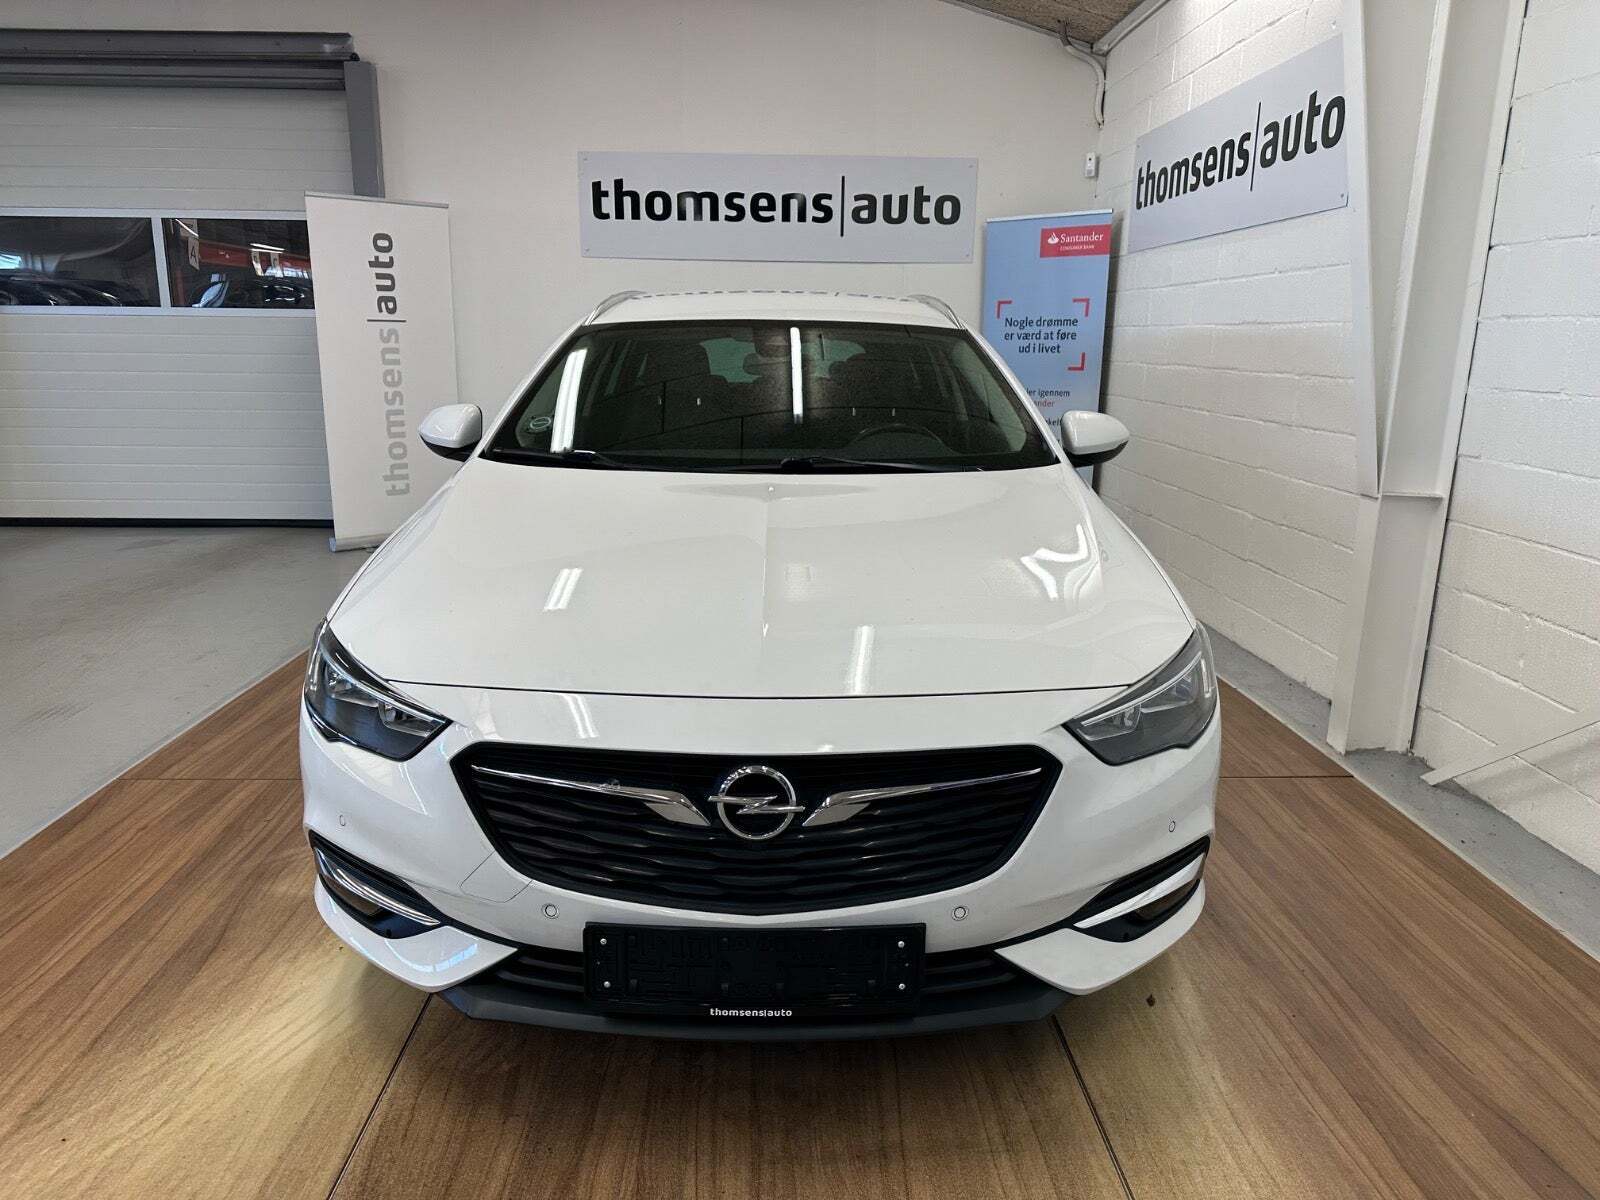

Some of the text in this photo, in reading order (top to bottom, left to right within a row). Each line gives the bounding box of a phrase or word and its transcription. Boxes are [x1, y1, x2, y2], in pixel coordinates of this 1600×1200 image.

[1060, 231, 1104, 243] Santander
[1004, 316, 1079, 330] Nogle drømme
[1004, 329, 1077, 340] er værd at føre
[1018, 343, 1031, 353] ud
[1038, 343, 1061, 353] livet
[1026, 387, 1070, 398] ler igennem
